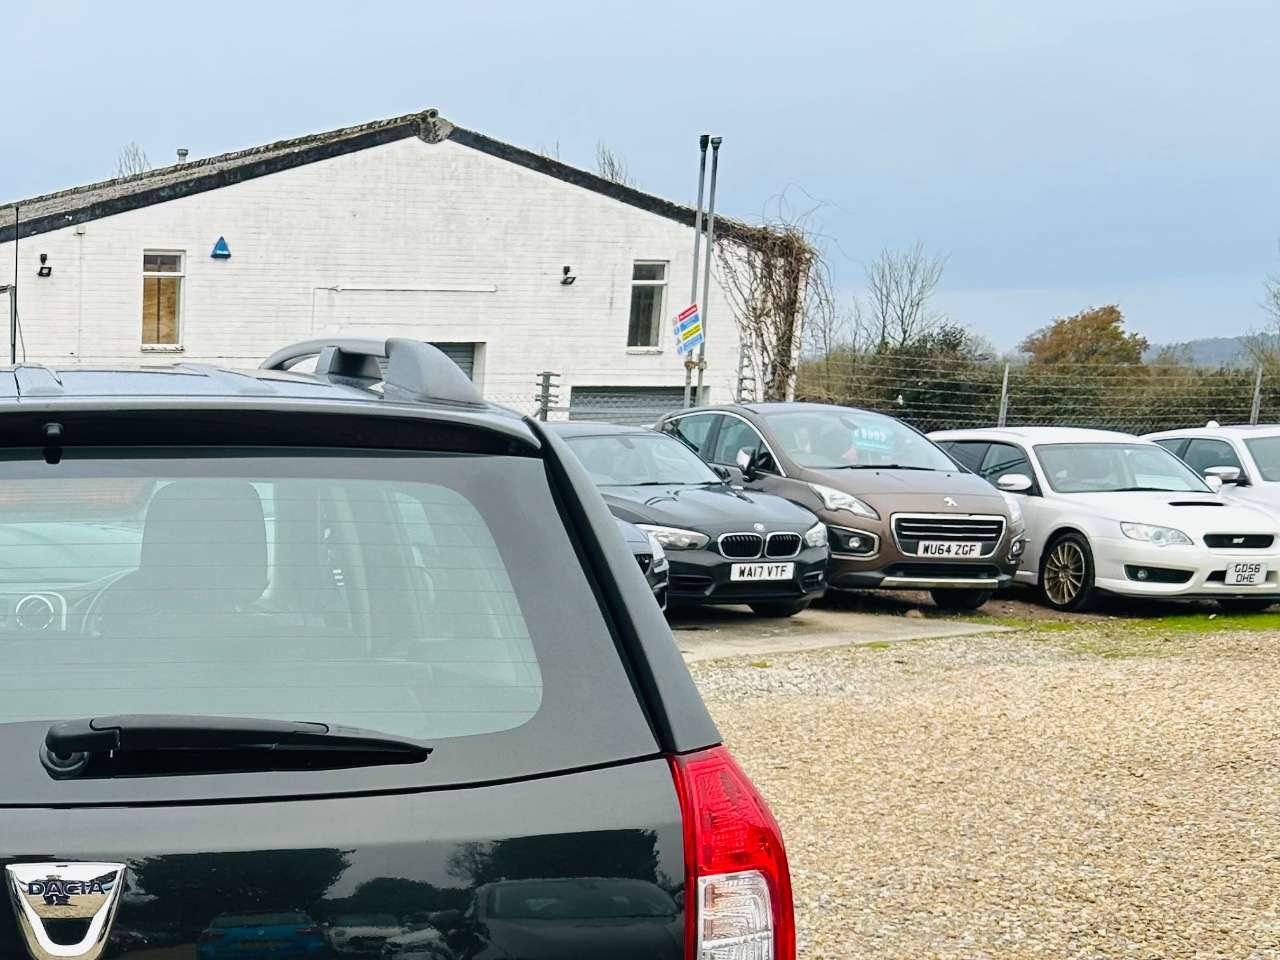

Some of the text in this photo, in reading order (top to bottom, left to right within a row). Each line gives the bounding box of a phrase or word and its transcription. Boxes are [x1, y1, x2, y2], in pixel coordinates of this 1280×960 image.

[922, 542, 977, 556] WU64 ZGF
[739, 564, 788, 578] WA17 VTF
[27, 881, 107, 896] DACIA
